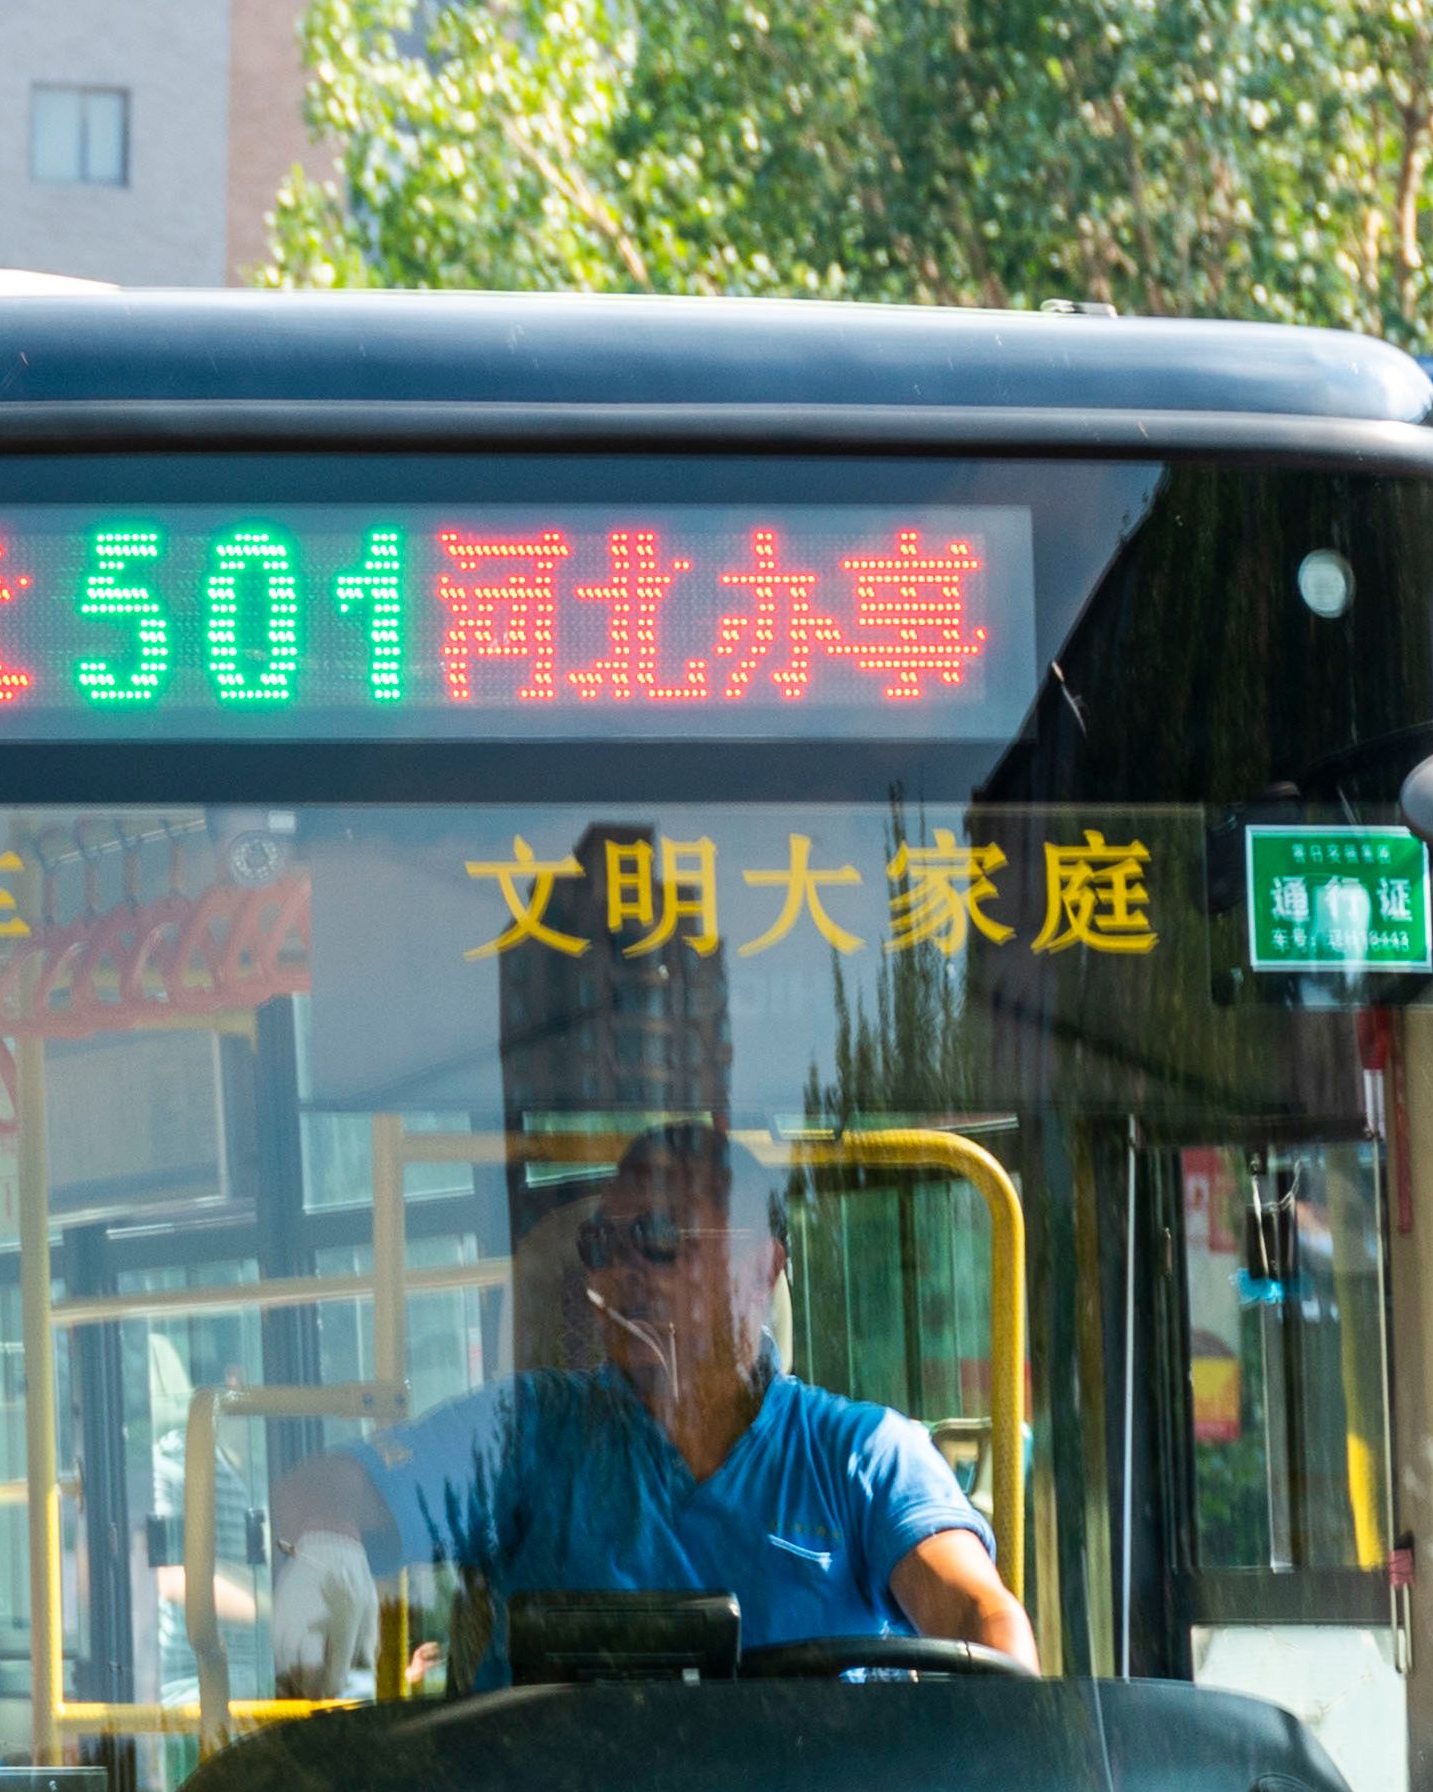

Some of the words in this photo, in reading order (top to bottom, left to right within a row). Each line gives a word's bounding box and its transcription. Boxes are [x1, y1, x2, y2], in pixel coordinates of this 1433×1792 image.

[76, 519, 405, 708] 501
[464, 828, 1159, 961] 文明大家庭
[1270, 874, 1413, 923] 通行证
